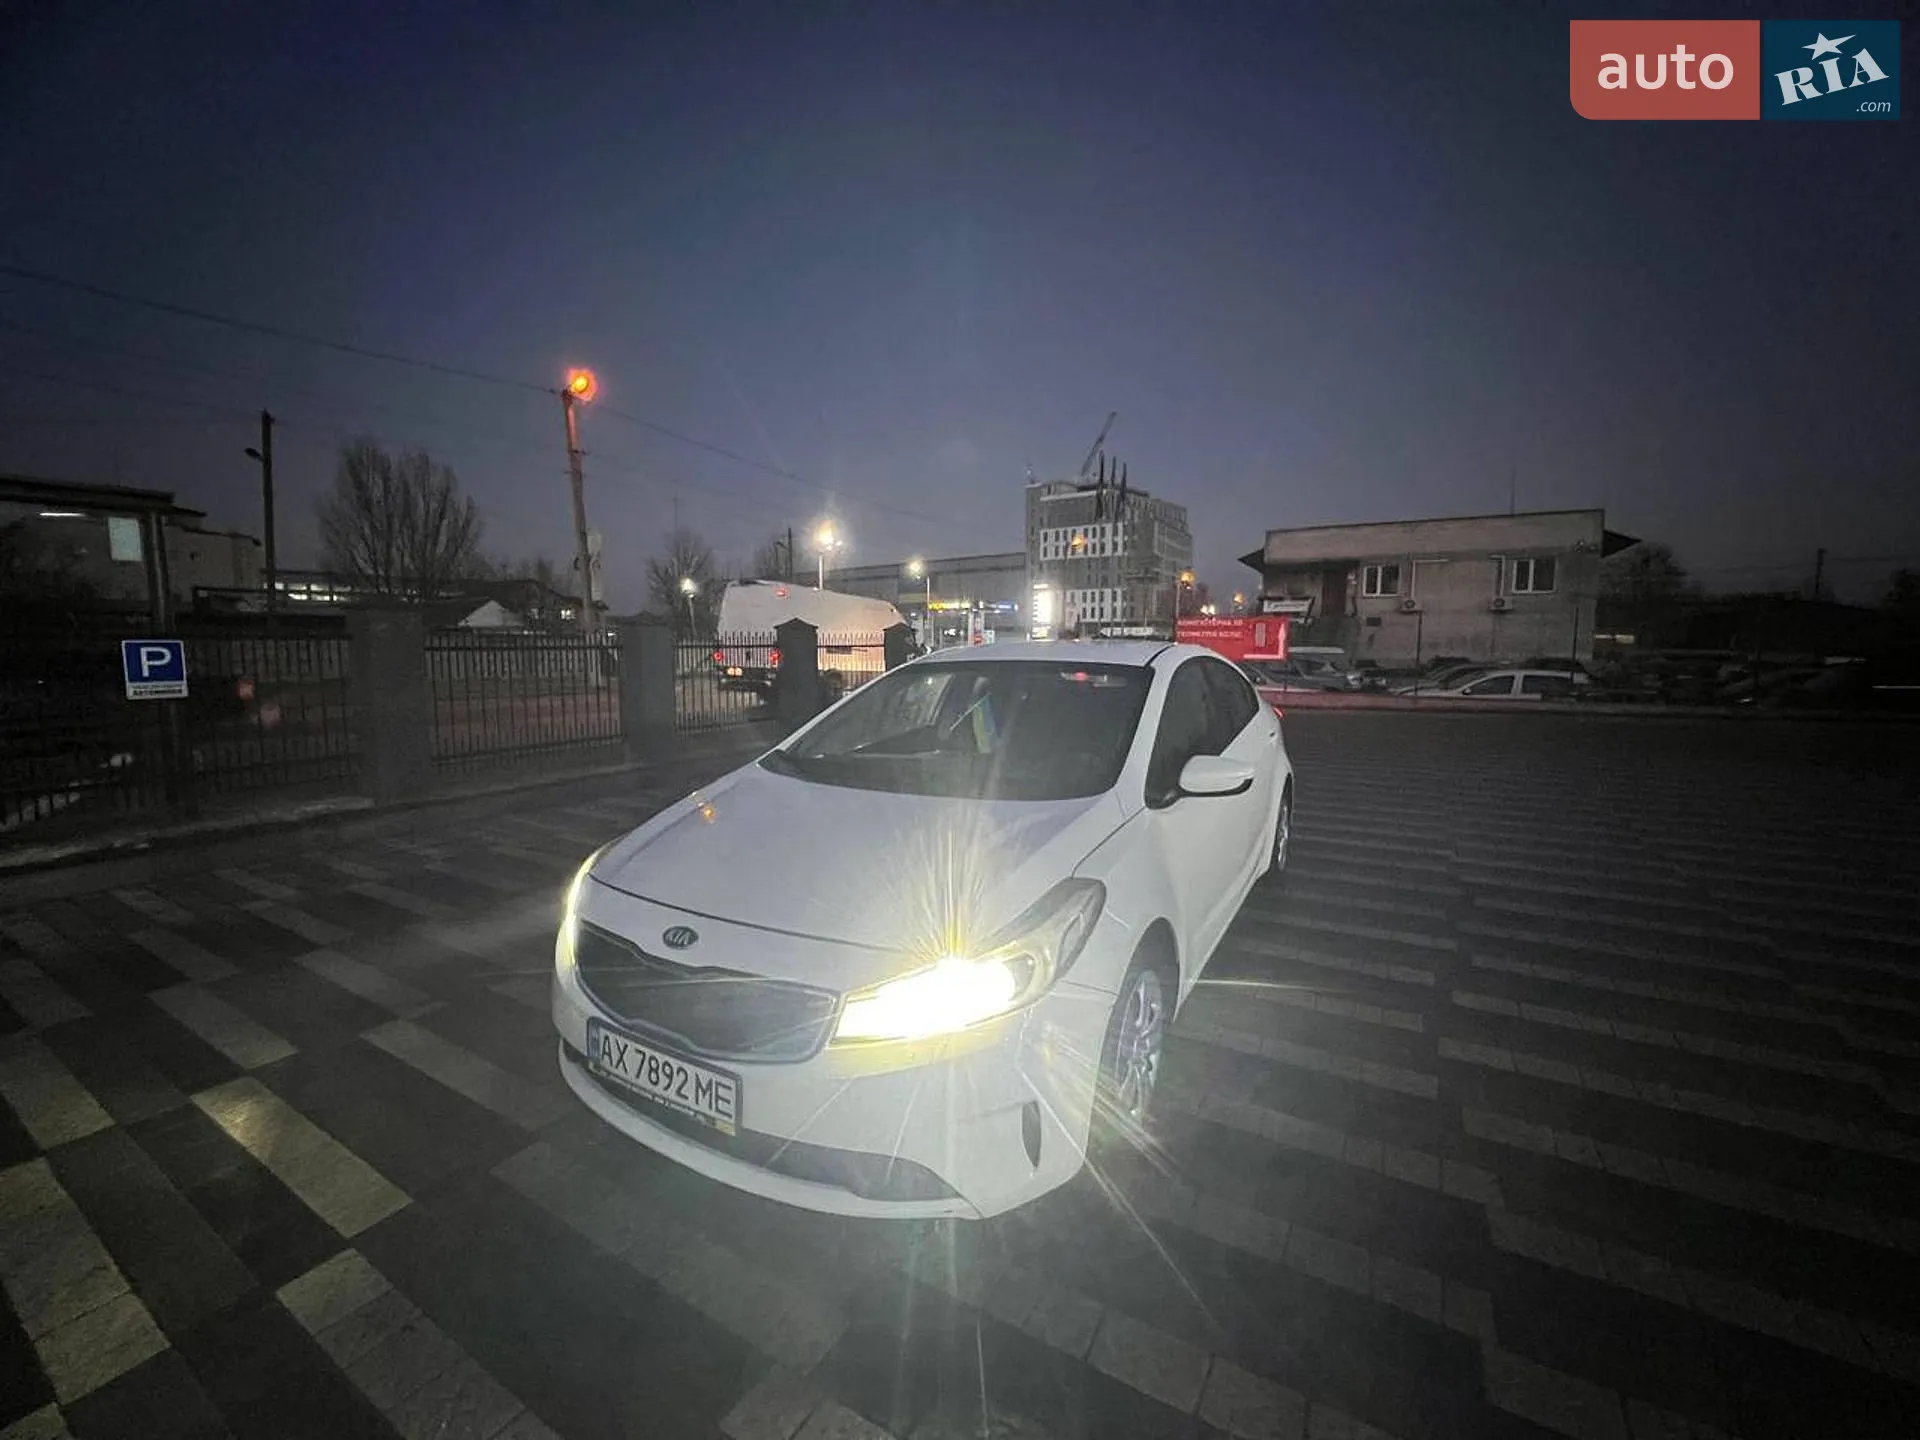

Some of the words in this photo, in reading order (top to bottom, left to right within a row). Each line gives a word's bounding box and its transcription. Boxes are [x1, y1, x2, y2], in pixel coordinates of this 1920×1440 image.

[141, 647, 172, 677] P
[601, 1035, 629, 1075] AX
[635, 1050, 689, 1100] 7892
[694, 1071, 733, 1118] ME
